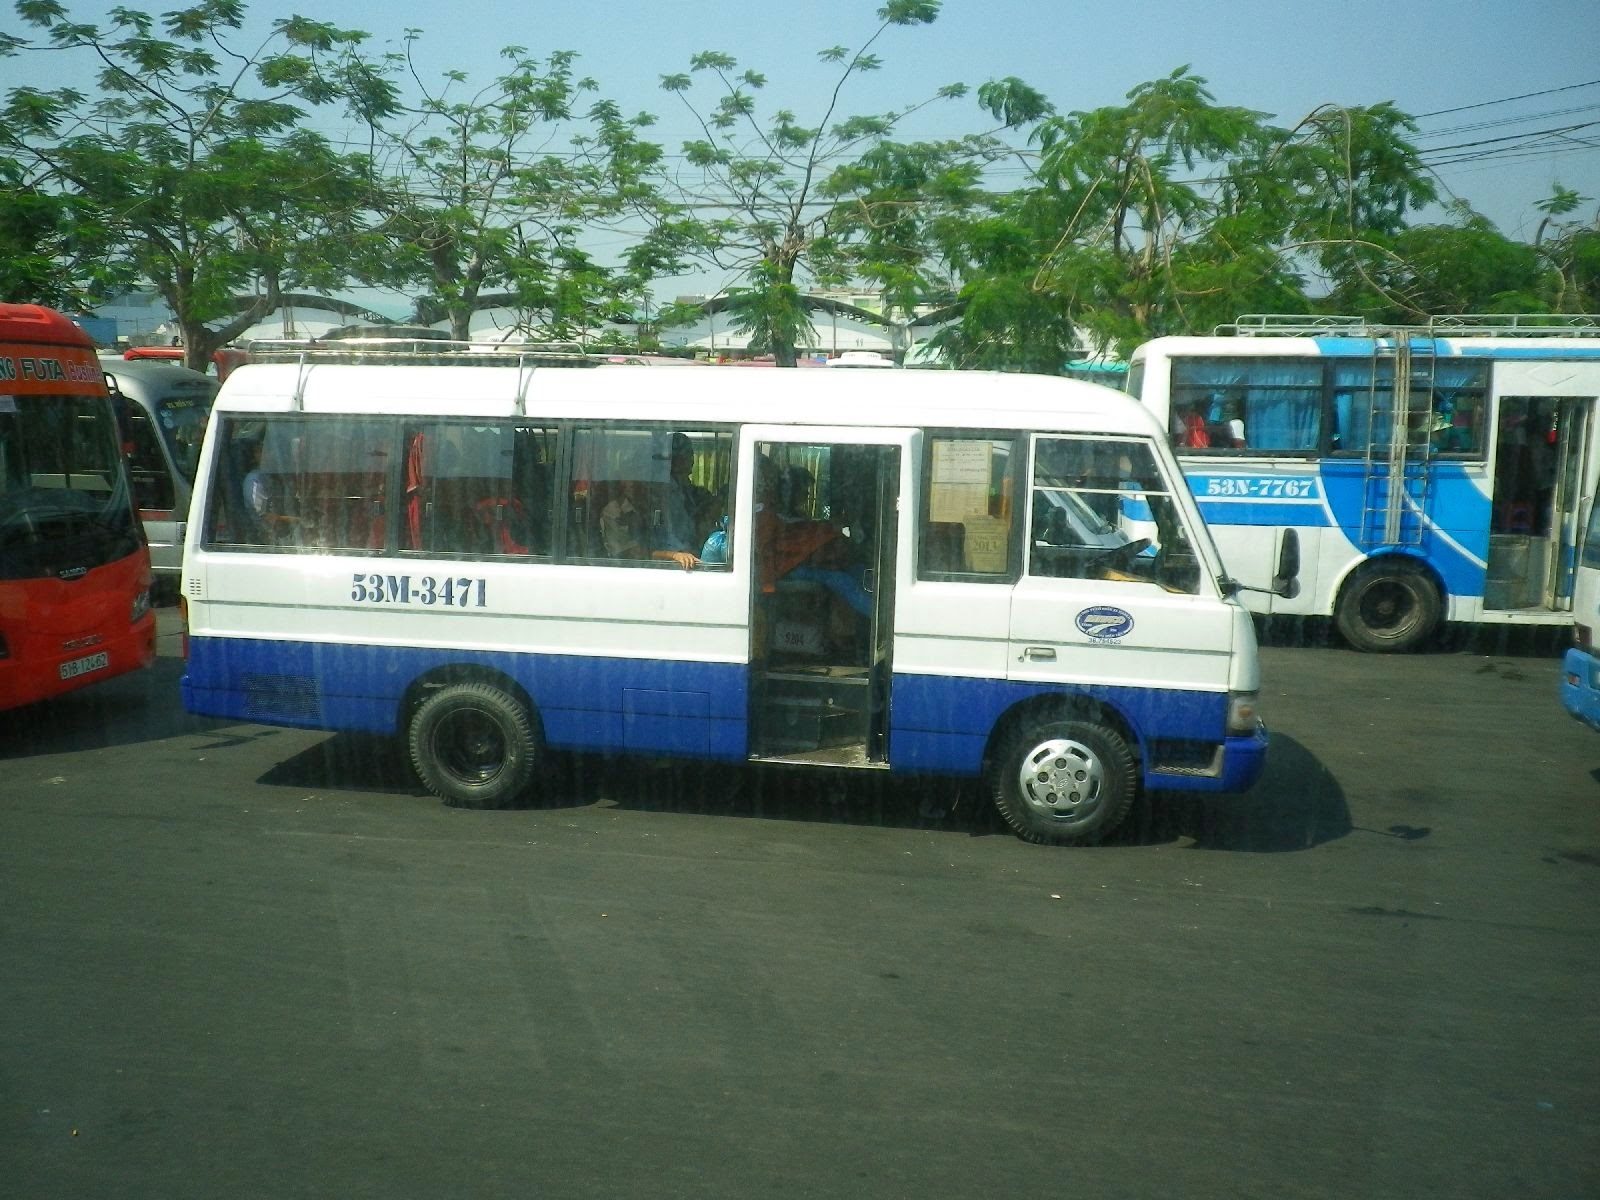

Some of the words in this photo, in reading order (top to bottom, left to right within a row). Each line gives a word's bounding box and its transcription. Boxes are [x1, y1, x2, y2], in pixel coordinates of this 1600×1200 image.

[19, 357, 68, 382] FUTA
[1208, 478, 1313, 497] 53N-7767
[351, 573, 487, 608] 53M-3471
